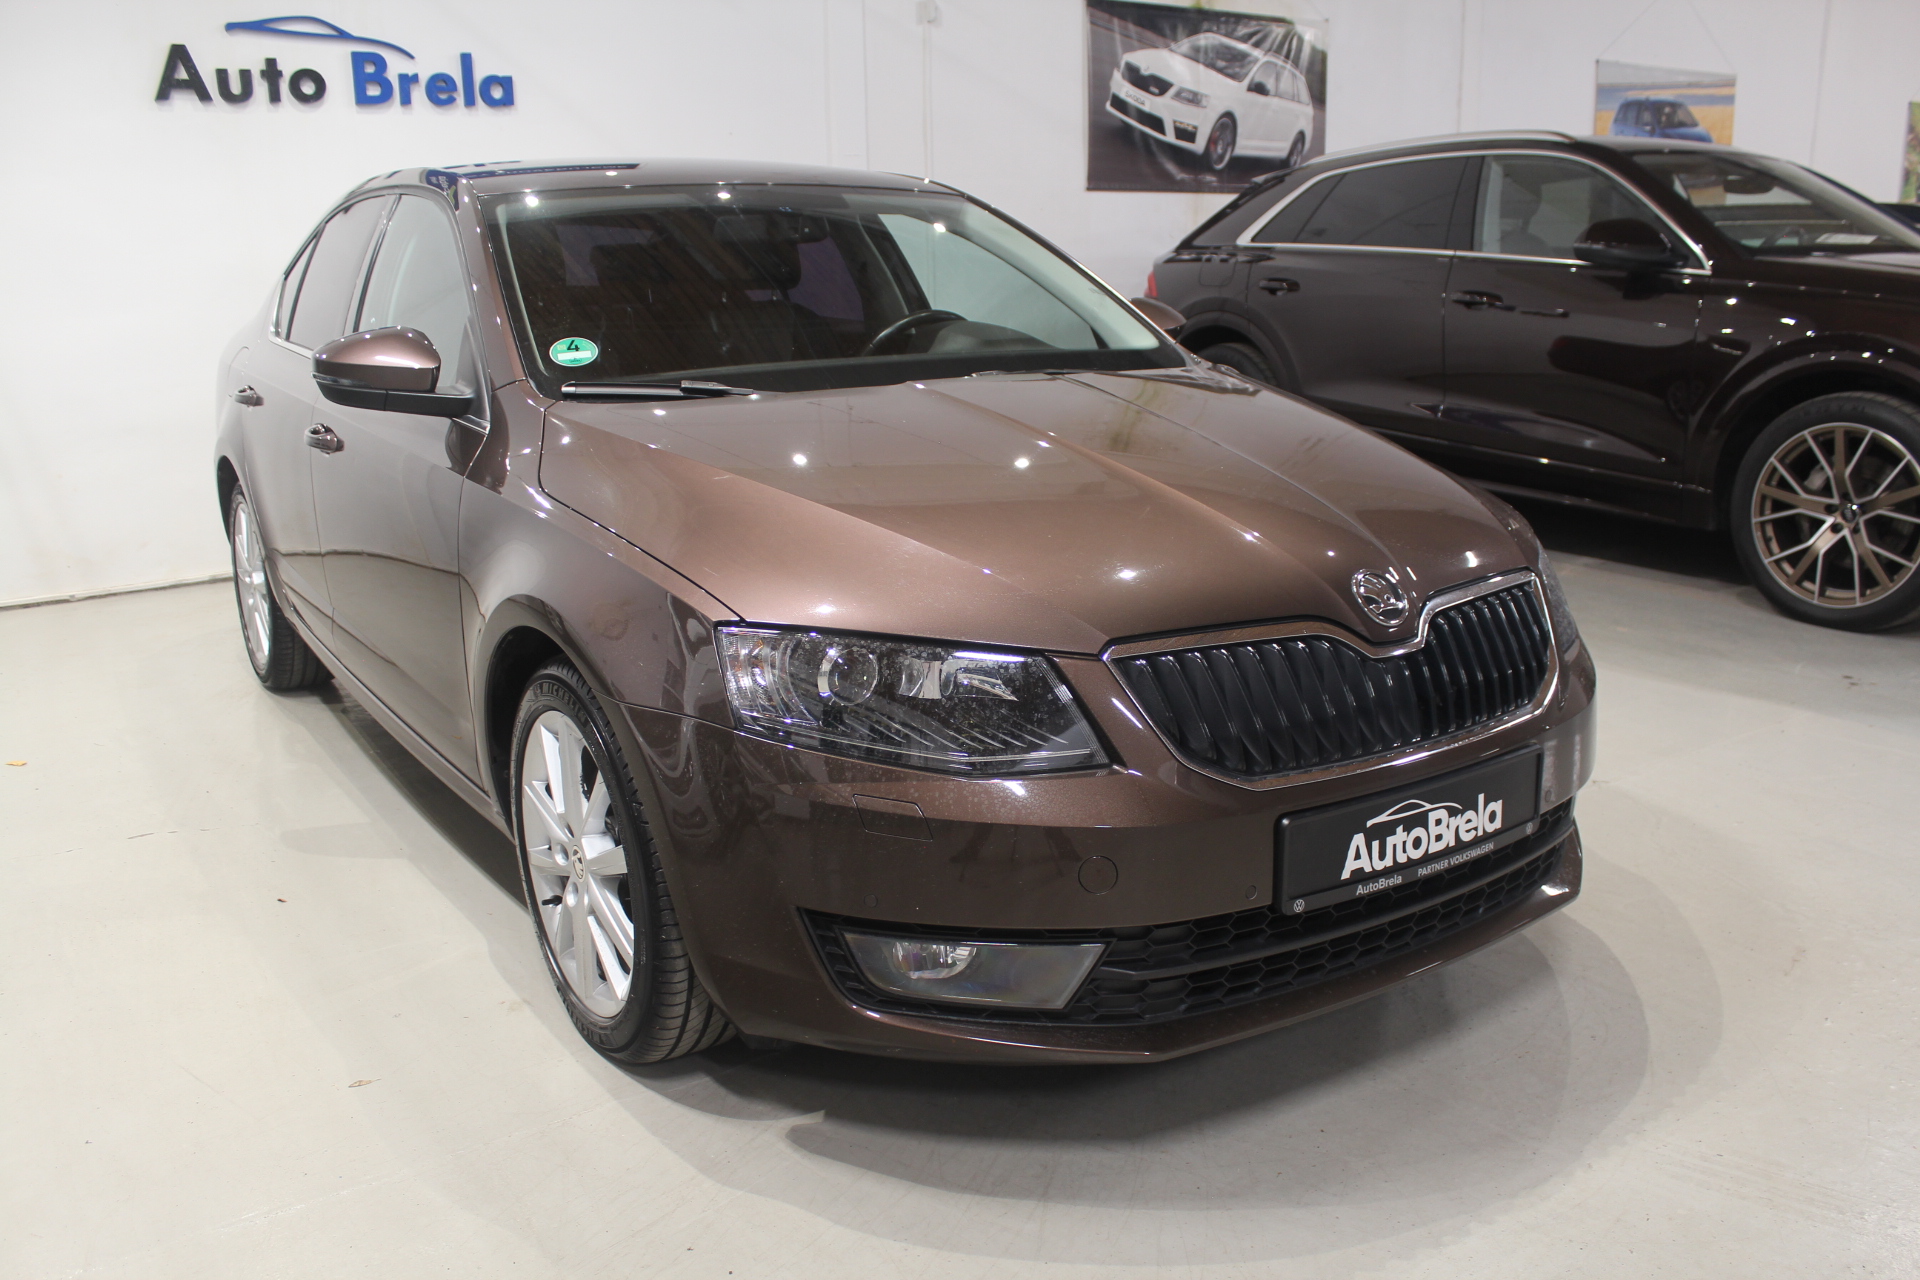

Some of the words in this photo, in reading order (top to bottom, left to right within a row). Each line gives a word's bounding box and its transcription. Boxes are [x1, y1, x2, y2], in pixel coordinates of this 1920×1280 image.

[155, 43, 327, 104] Auto
[350, 50, 515, 107] Brela
[567, 339, 580, 352] 4
[542, 682, 588, 727] MICHELIN
[1341, 793, 1503, 880] AutoBrela
[1356, 875, 1403, 896] AutoBrela
[1417, 860, 1449, 877] PARTNER
[1449, 842, 1495, 866] VOLKSWAGEN
